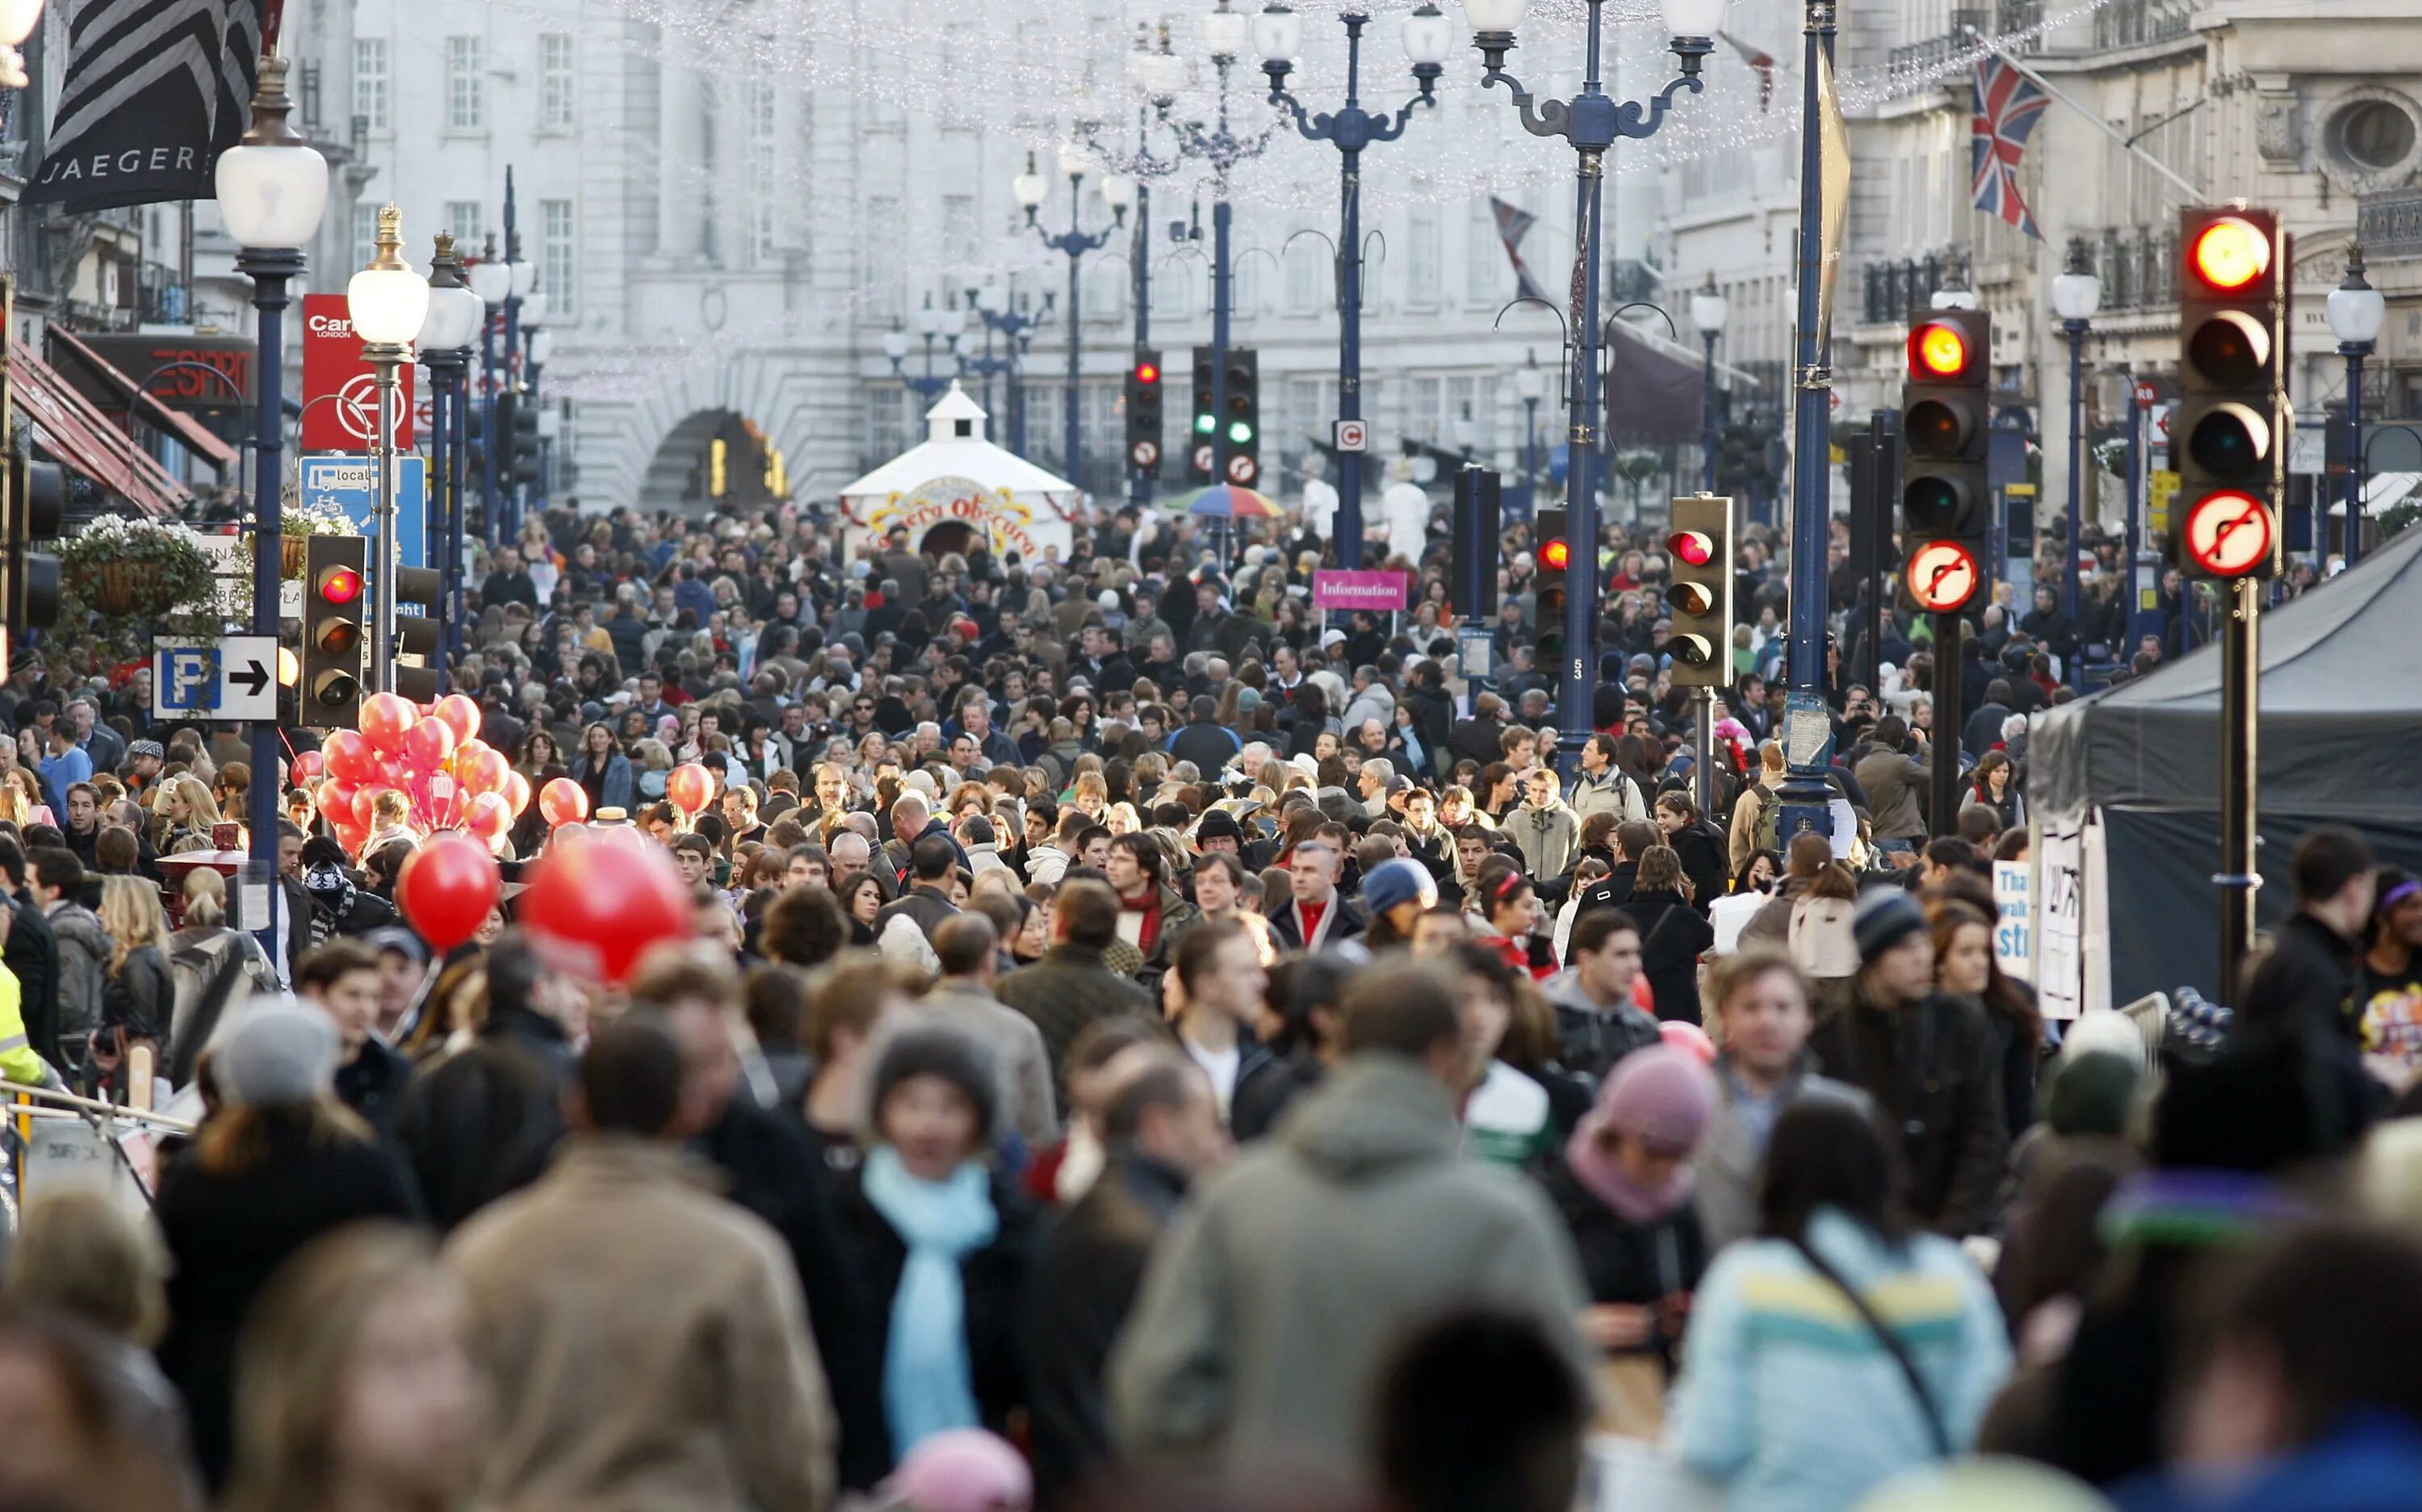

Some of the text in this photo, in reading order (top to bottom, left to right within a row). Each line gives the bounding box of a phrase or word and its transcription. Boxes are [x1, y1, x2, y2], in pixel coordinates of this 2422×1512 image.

[41, 146, 195, 184] JAEGER
[152, 349, 252, 398] ESPRIT
[337, 469, 370, 481] local
[1322, 580, 1397, 597] Information
